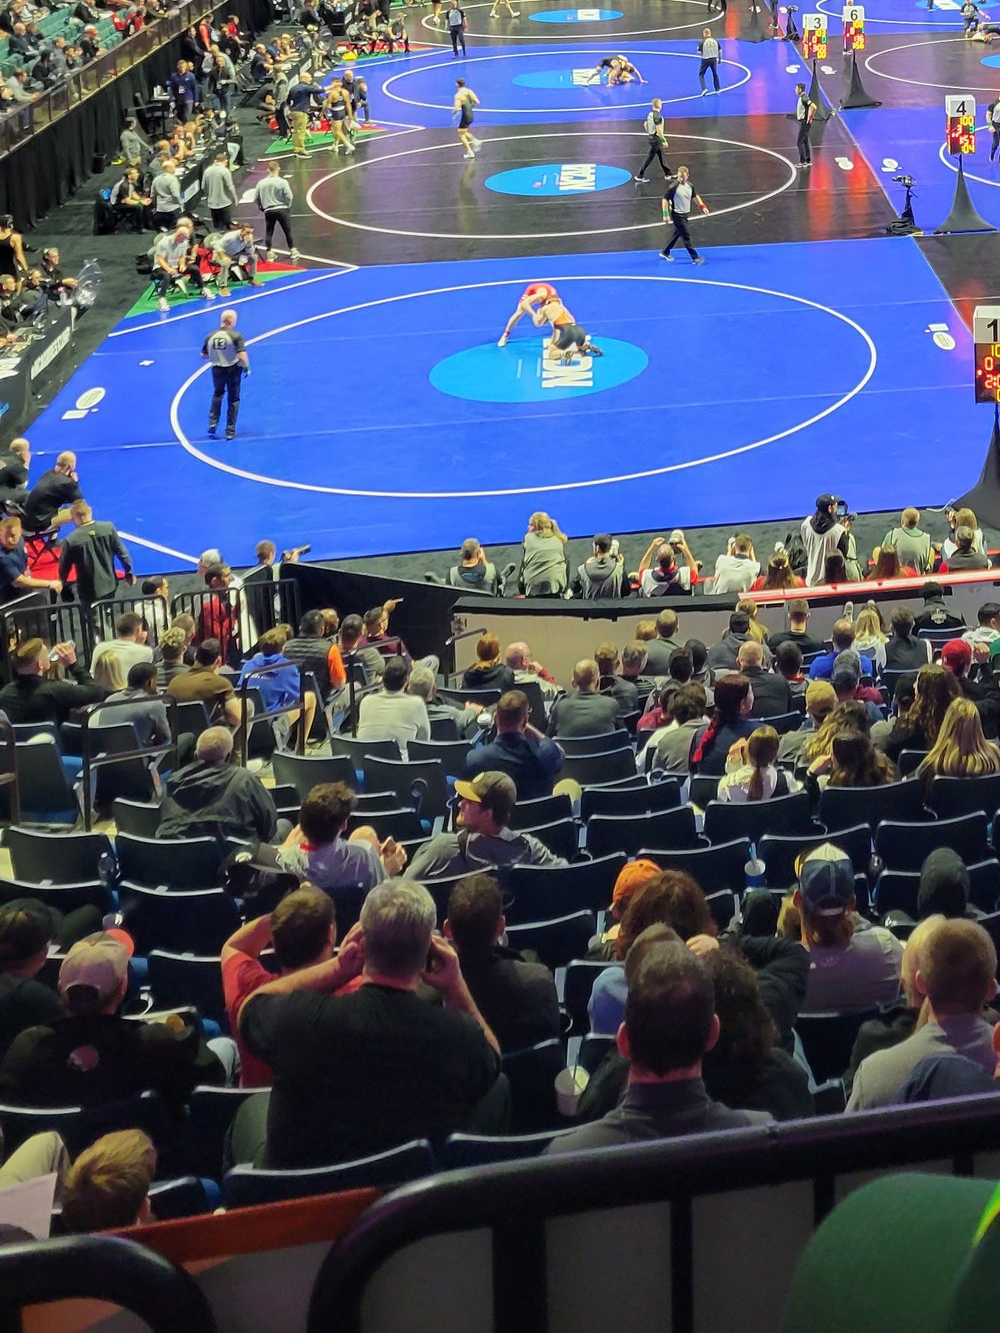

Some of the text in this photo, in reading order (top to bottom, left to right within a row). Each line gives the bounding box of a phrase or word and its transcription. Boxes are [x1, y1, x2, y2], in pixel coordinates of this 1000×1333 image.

[850, 9, 858, 21] 6
[813, 17, 821, 29] 3
[956, 100, 967, 115] 4
[986, 318, 998, 342] 1
[213, 338, 226, 350] 13
[984, 356, 994, 370] 0
